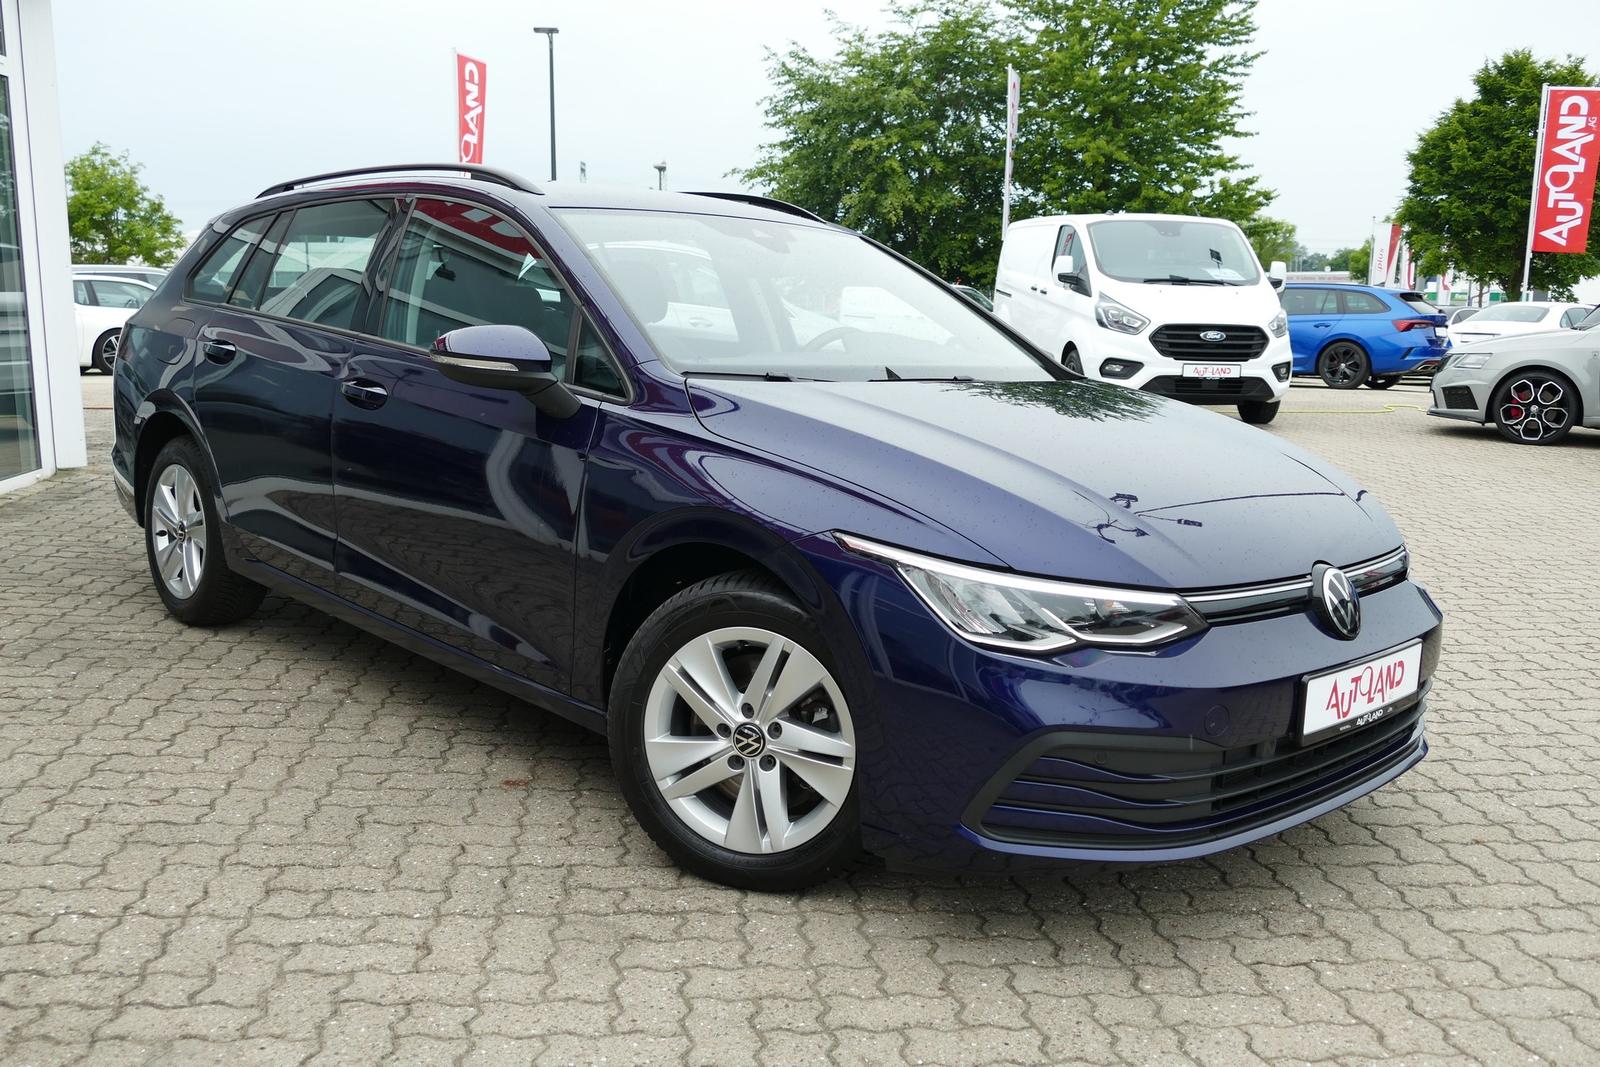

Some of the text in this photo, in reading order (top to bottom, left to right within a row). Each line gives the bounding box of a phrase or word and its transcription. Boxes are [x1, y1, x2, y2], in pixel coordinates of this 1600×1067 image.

[461, 62, 482, 164] OLAND
[1539, 95, 1595, 247] AUTOLAND
[1325, 660, 1405, 720] AUTOLAND
